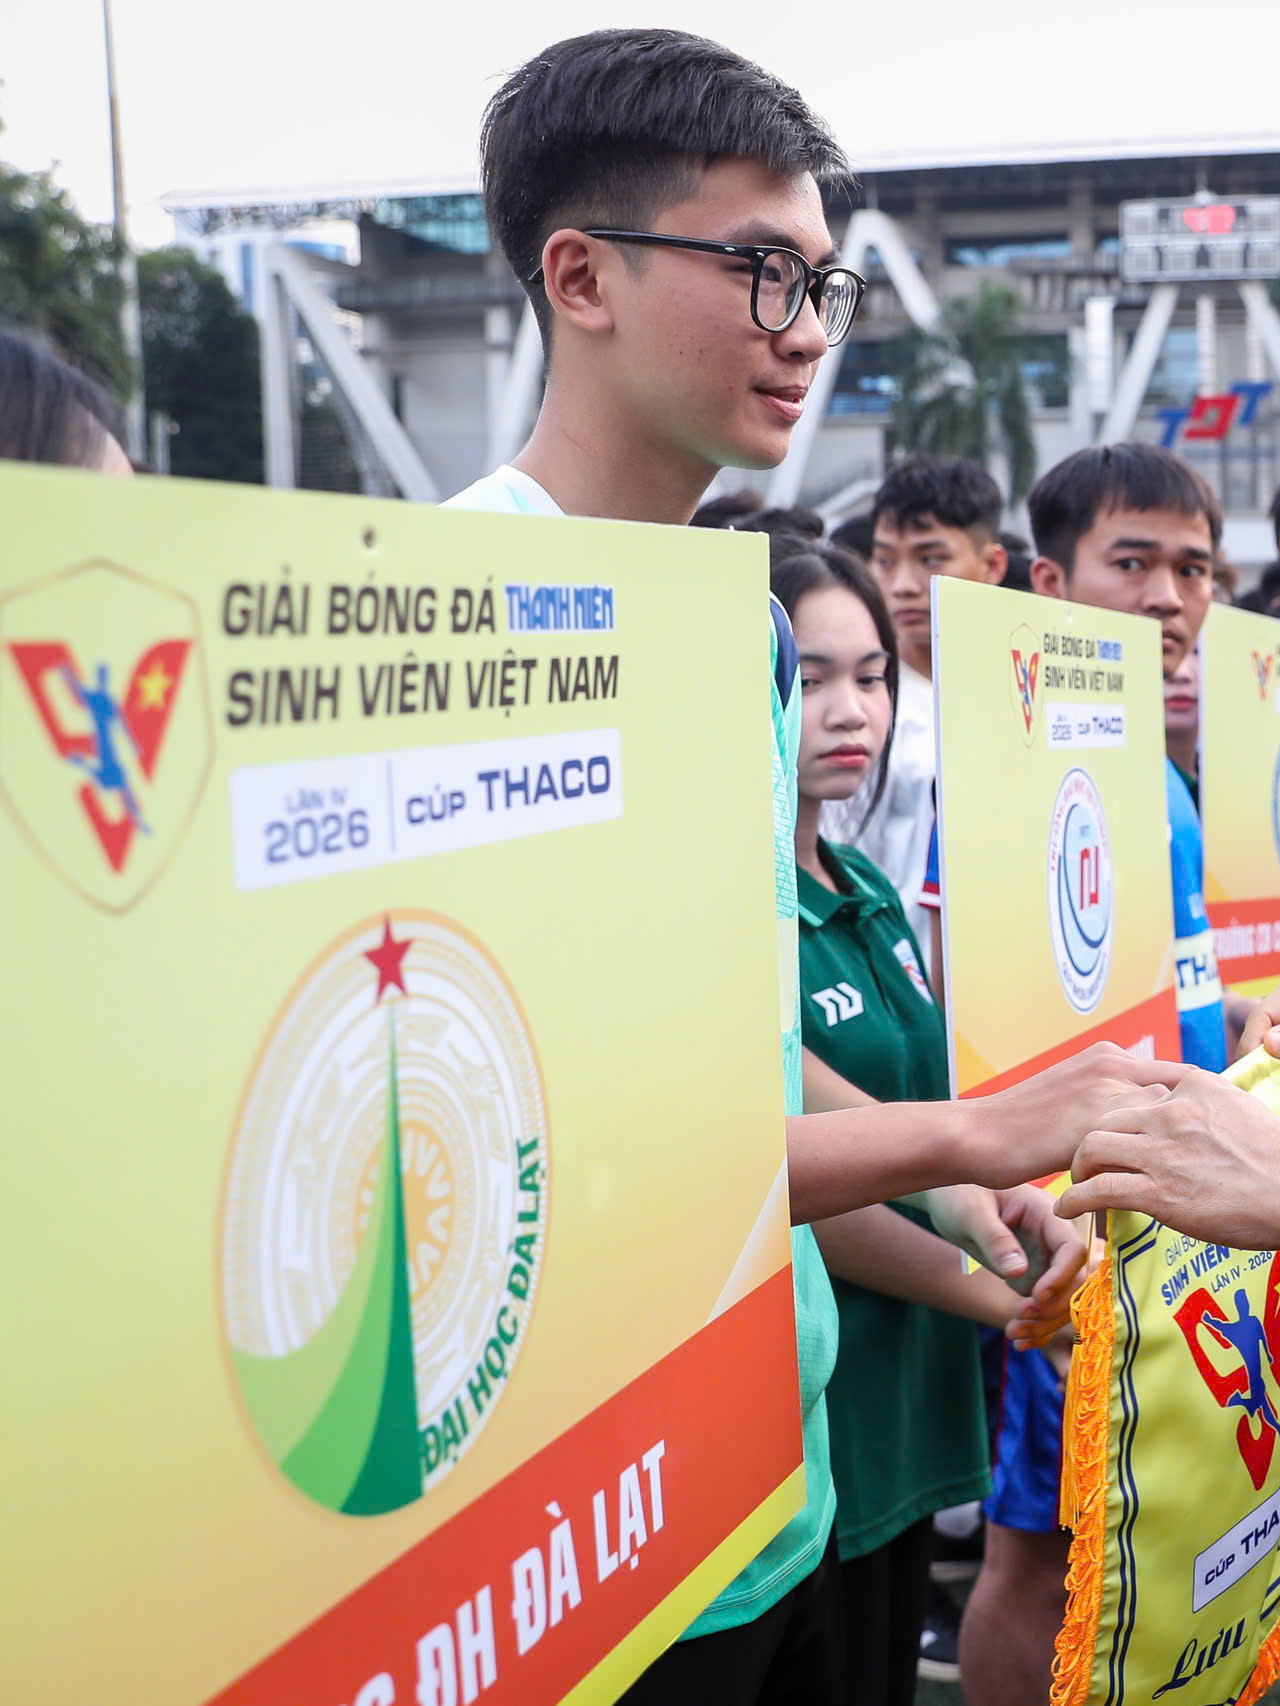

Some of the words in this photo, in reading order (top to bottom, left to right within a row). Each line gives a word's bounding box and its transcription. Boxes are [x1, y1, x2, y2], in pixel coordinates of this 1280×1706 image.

[222, 565, 309, 636] GIẢI
[327, 570, 437, 635] BÓNG
[450, 575, 496, 634] ĐÁ
[227, 666, 340, 727] SINH
[359, 651, 450, 717] VIÊN
[467, 649, 538, 718] VIỆT
[549, 656, 619, 703] NAM
[407, 785, 465, 824] CÚP
[478, 755, 611, 811] THACO
[265, 810, 369, 865] 2026
[1161, 1264, 1189, 1306] SINH
[1190, 1244, 1230, 1278] VIÊN
[1248, 1251, 1272, 1270] 2026
[511, 1500, 582, 1656] ĐÀ
[593, 1439, 665, 1583] LẠT
[1205, 1554, 1235, 1585] CÚP
